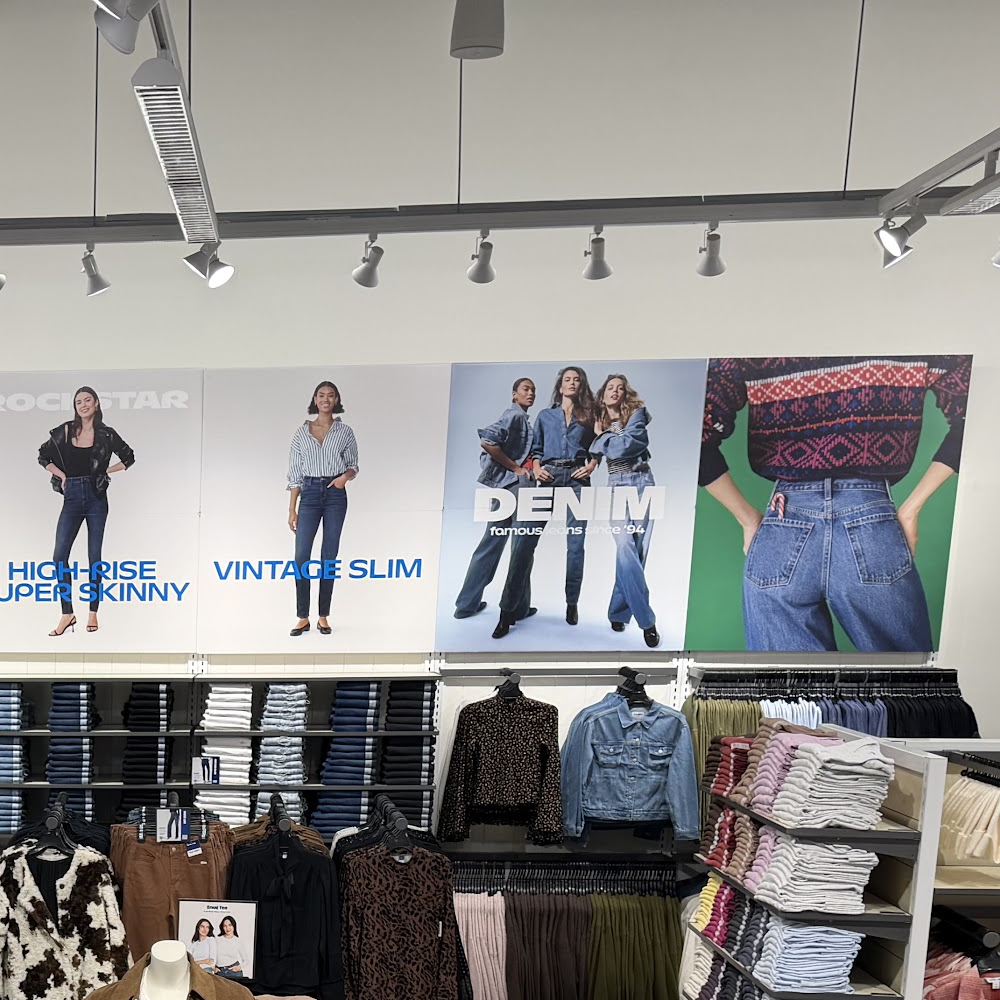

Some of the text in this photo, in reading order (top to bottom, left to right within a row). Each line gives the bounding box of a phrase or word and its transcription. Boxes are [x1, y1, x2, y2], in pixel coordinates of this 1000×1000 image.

[473, 486, 667, 522] DENIM
[489, 526, 543, 536] famous
[585, 525, 621, 535] since
[8, 561, 157, 580] HIGH-RISE
[213, 558, 423, 580] VINTAGE SLIM
[79, 582, 190, 602] SKINNY
